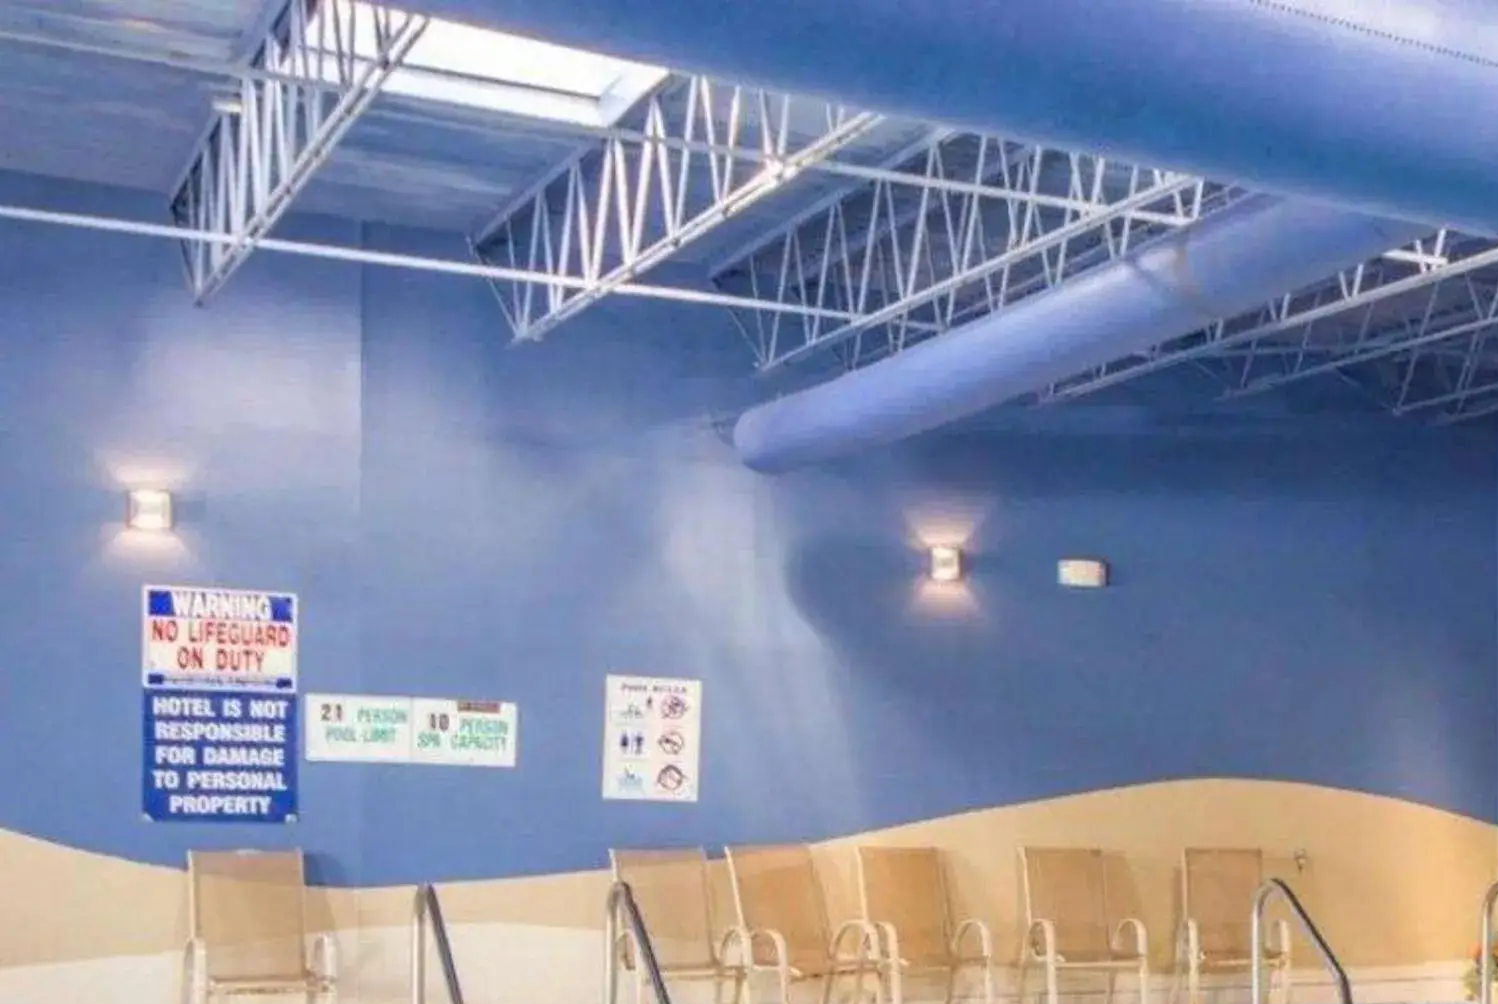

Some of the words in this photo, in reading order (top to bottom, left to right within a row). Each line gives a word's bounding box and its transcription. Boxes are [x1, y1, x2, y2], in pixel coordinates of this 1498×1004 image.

[174, 591, 273, 619] WARNING
[152, 619, 178, 642] NO
[188, 621, 290, 647] LIFEGUARD
[177, 646, 203, 669] ON
[216, 648, 264, 671] DUTY
[153, 696, 216, 718] HOTEL
[222, 698, 242, 718] IS
[250, 699, 288, 719] NOT
[320, 703, 342, 721] 21
[154, 721, 286, 742] RESPONSIBLE
[155, 745, 196, 765] FOR
[203, 746, 285, 767] DAMAGE
[152, 769, 179, 789] TO
[186, 770, 287, 791] PERSONAL
[169, 795, 272, 815] PROPERTY
